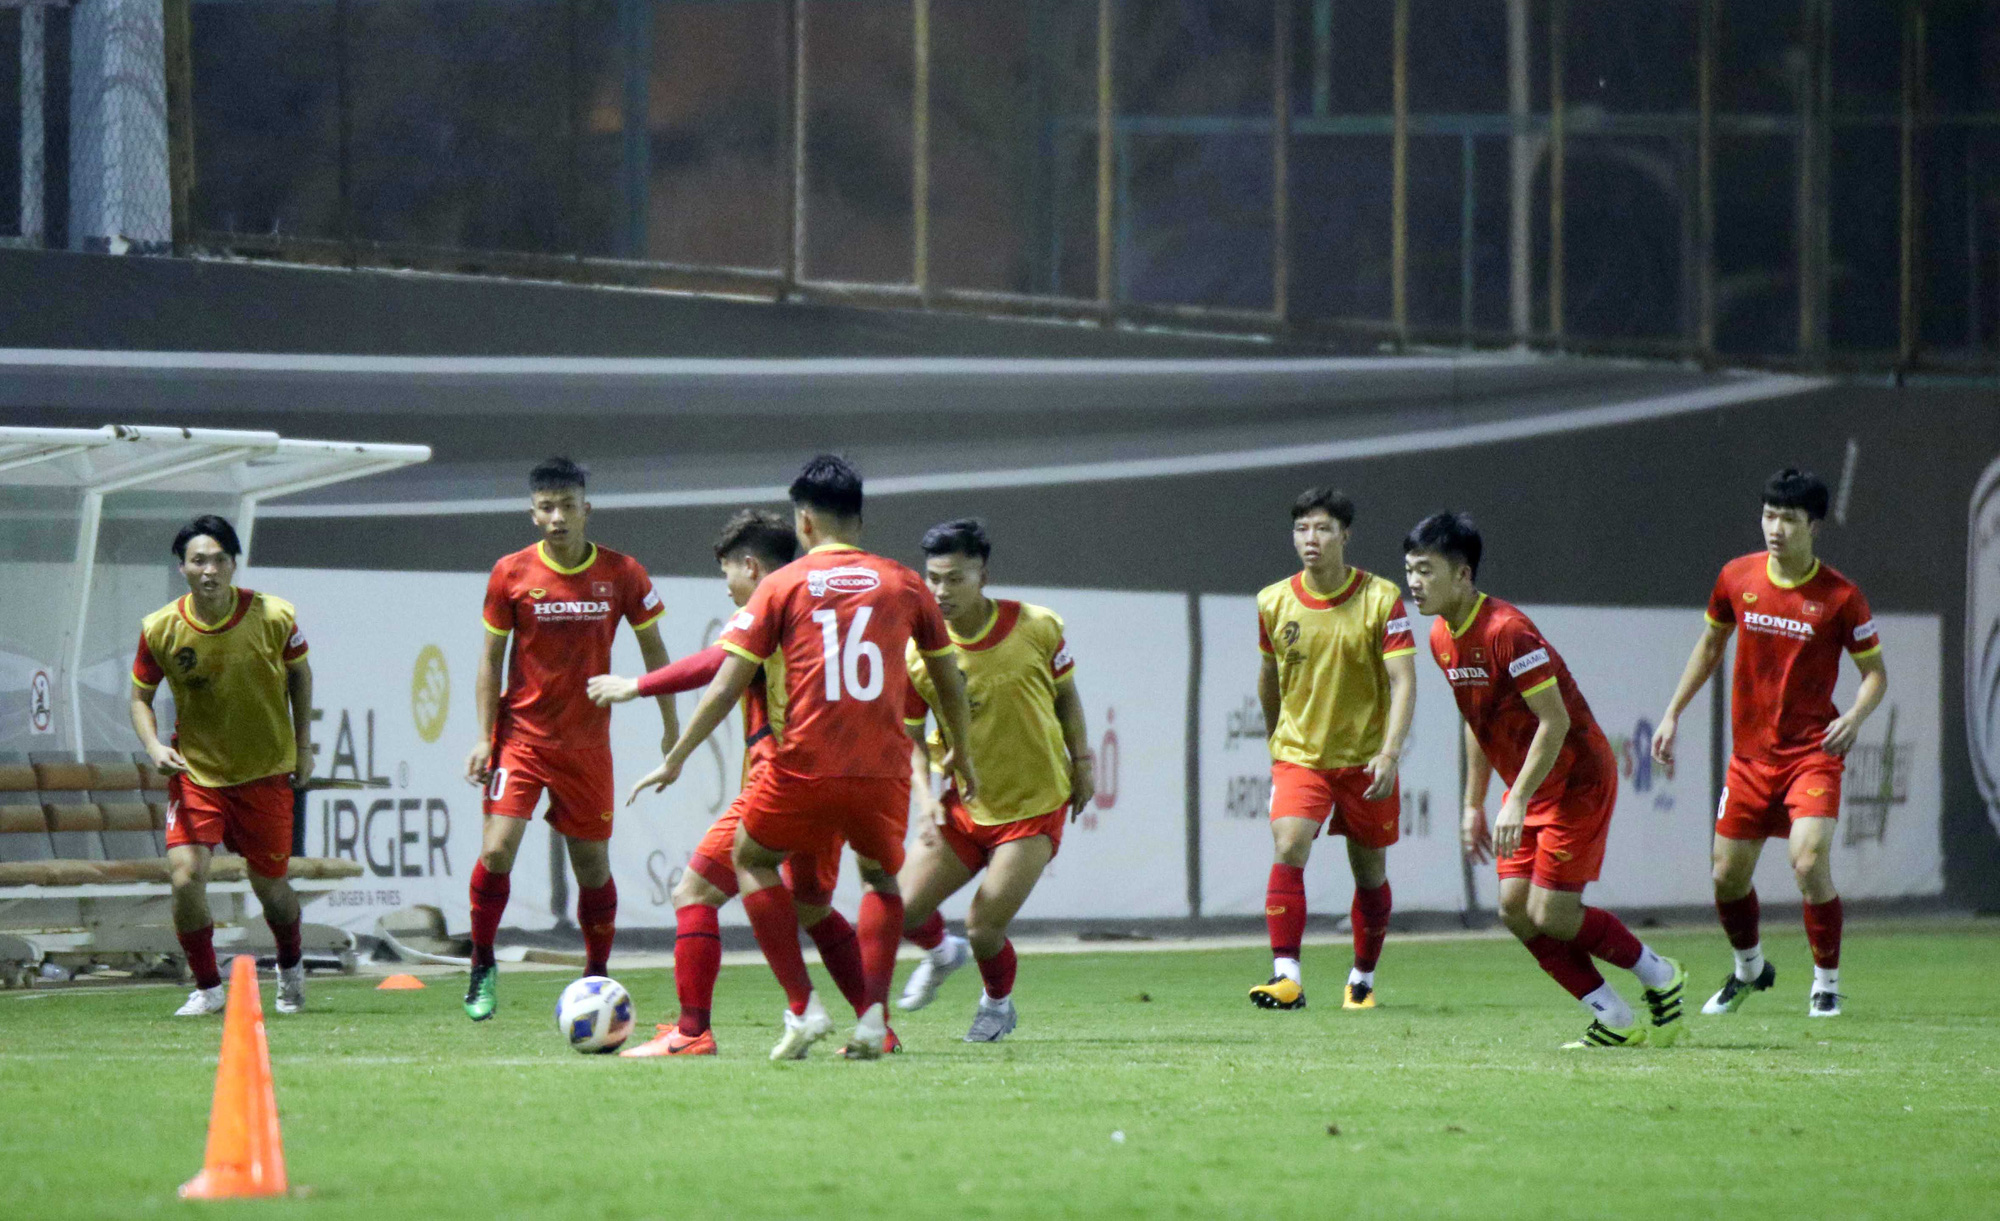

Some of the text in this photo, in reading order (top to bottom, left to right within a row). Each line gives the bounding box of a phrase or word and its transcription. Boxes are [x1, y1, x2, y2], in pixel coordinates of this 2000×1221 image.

[534, 601, 611, 614] HONDA
[1744, 611, 1815, 635] HONDA
[812, 606, 884, 702] 16
[1447, 667, 1489, 680] ONDA
